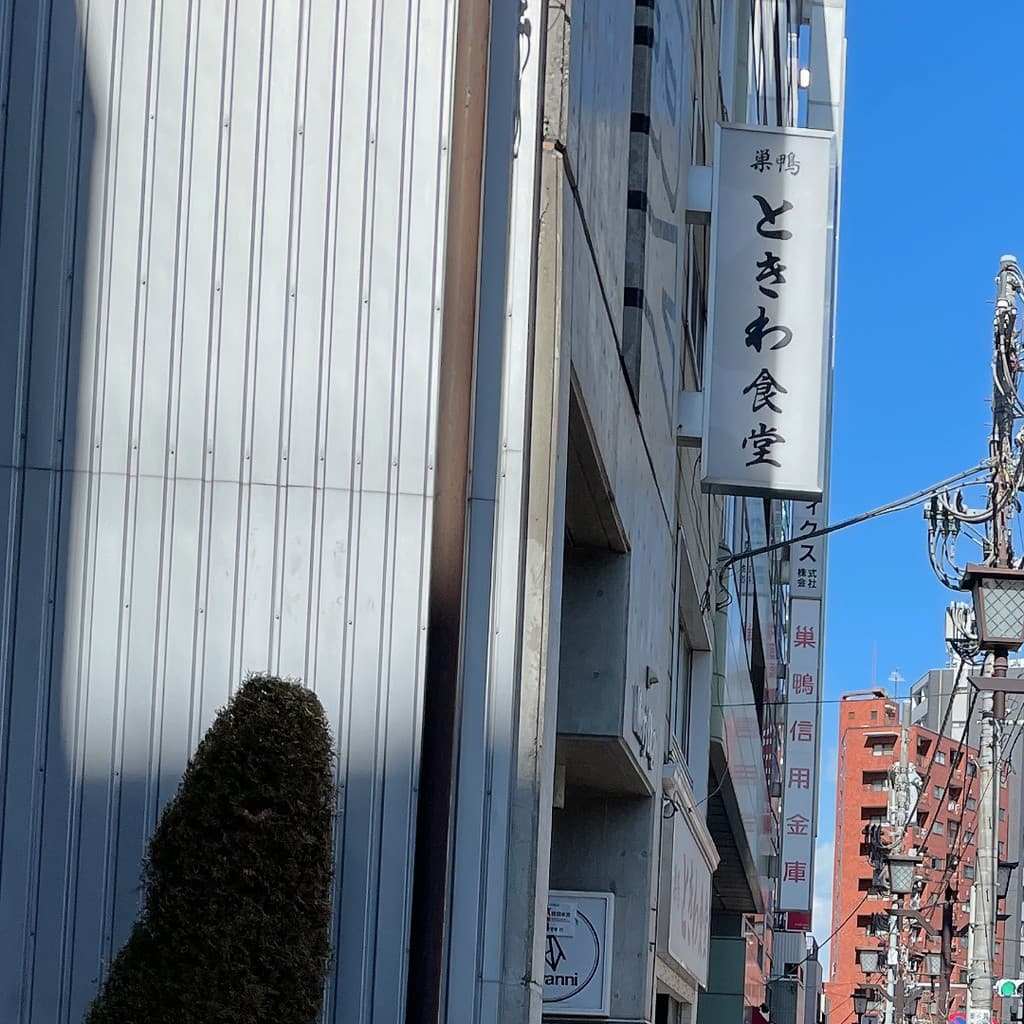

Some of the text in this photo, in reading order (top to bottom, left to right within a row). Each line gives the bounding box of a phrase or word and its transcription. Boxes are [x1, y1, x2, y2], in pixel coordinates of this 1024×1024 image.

[750, 150, 801, 177] 巣鴨
[742, 194, 793, 469] ときわ食堂
[783, 625, 816, 884] 巣鴨信用金庫
[544, 973, 578, 986] anni
